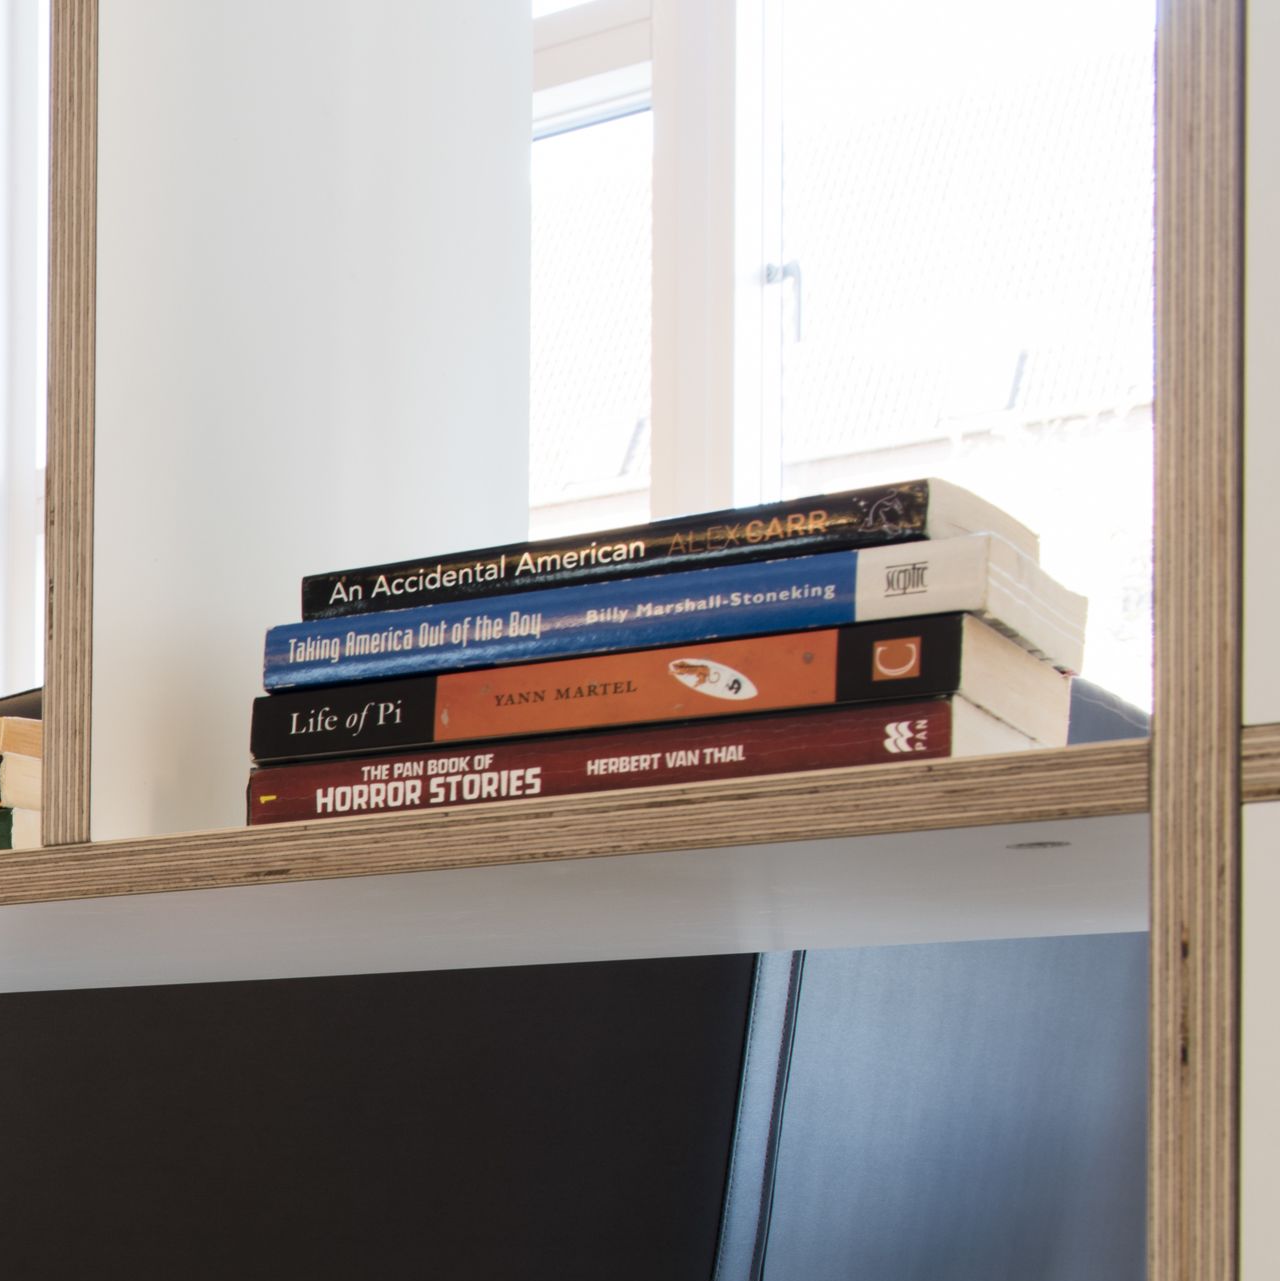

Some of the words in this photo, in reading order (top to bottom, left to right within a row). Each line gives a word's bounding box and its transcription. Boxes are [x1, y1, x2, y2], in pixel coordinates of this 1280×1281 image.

[329, 582, 362, 605] An
[371, 555, 506, 599] Accidental
[515, 539, 645, 577] American
[494, 690, 546, 707] YANN
[555, 680, 638, 701] MARTEL
[290, 706, 338, 735] Life
[345, 702, 375, 737] of
[377, 699, 403, 725] Pi
[362, 765, 391, 781] THE
[393, 761, 423, 777] PAN
[427, 757, 470, 773] BOOK
[473, 753, 494, 769] OF
[587, 752, 662, 776] HERBERT
[666, 749, 700, 768] VAN
[702, 744, 746, 764] THAL
[316, 779, 422, 813] HORROR
[429, 766, 542, 803] STORIES
